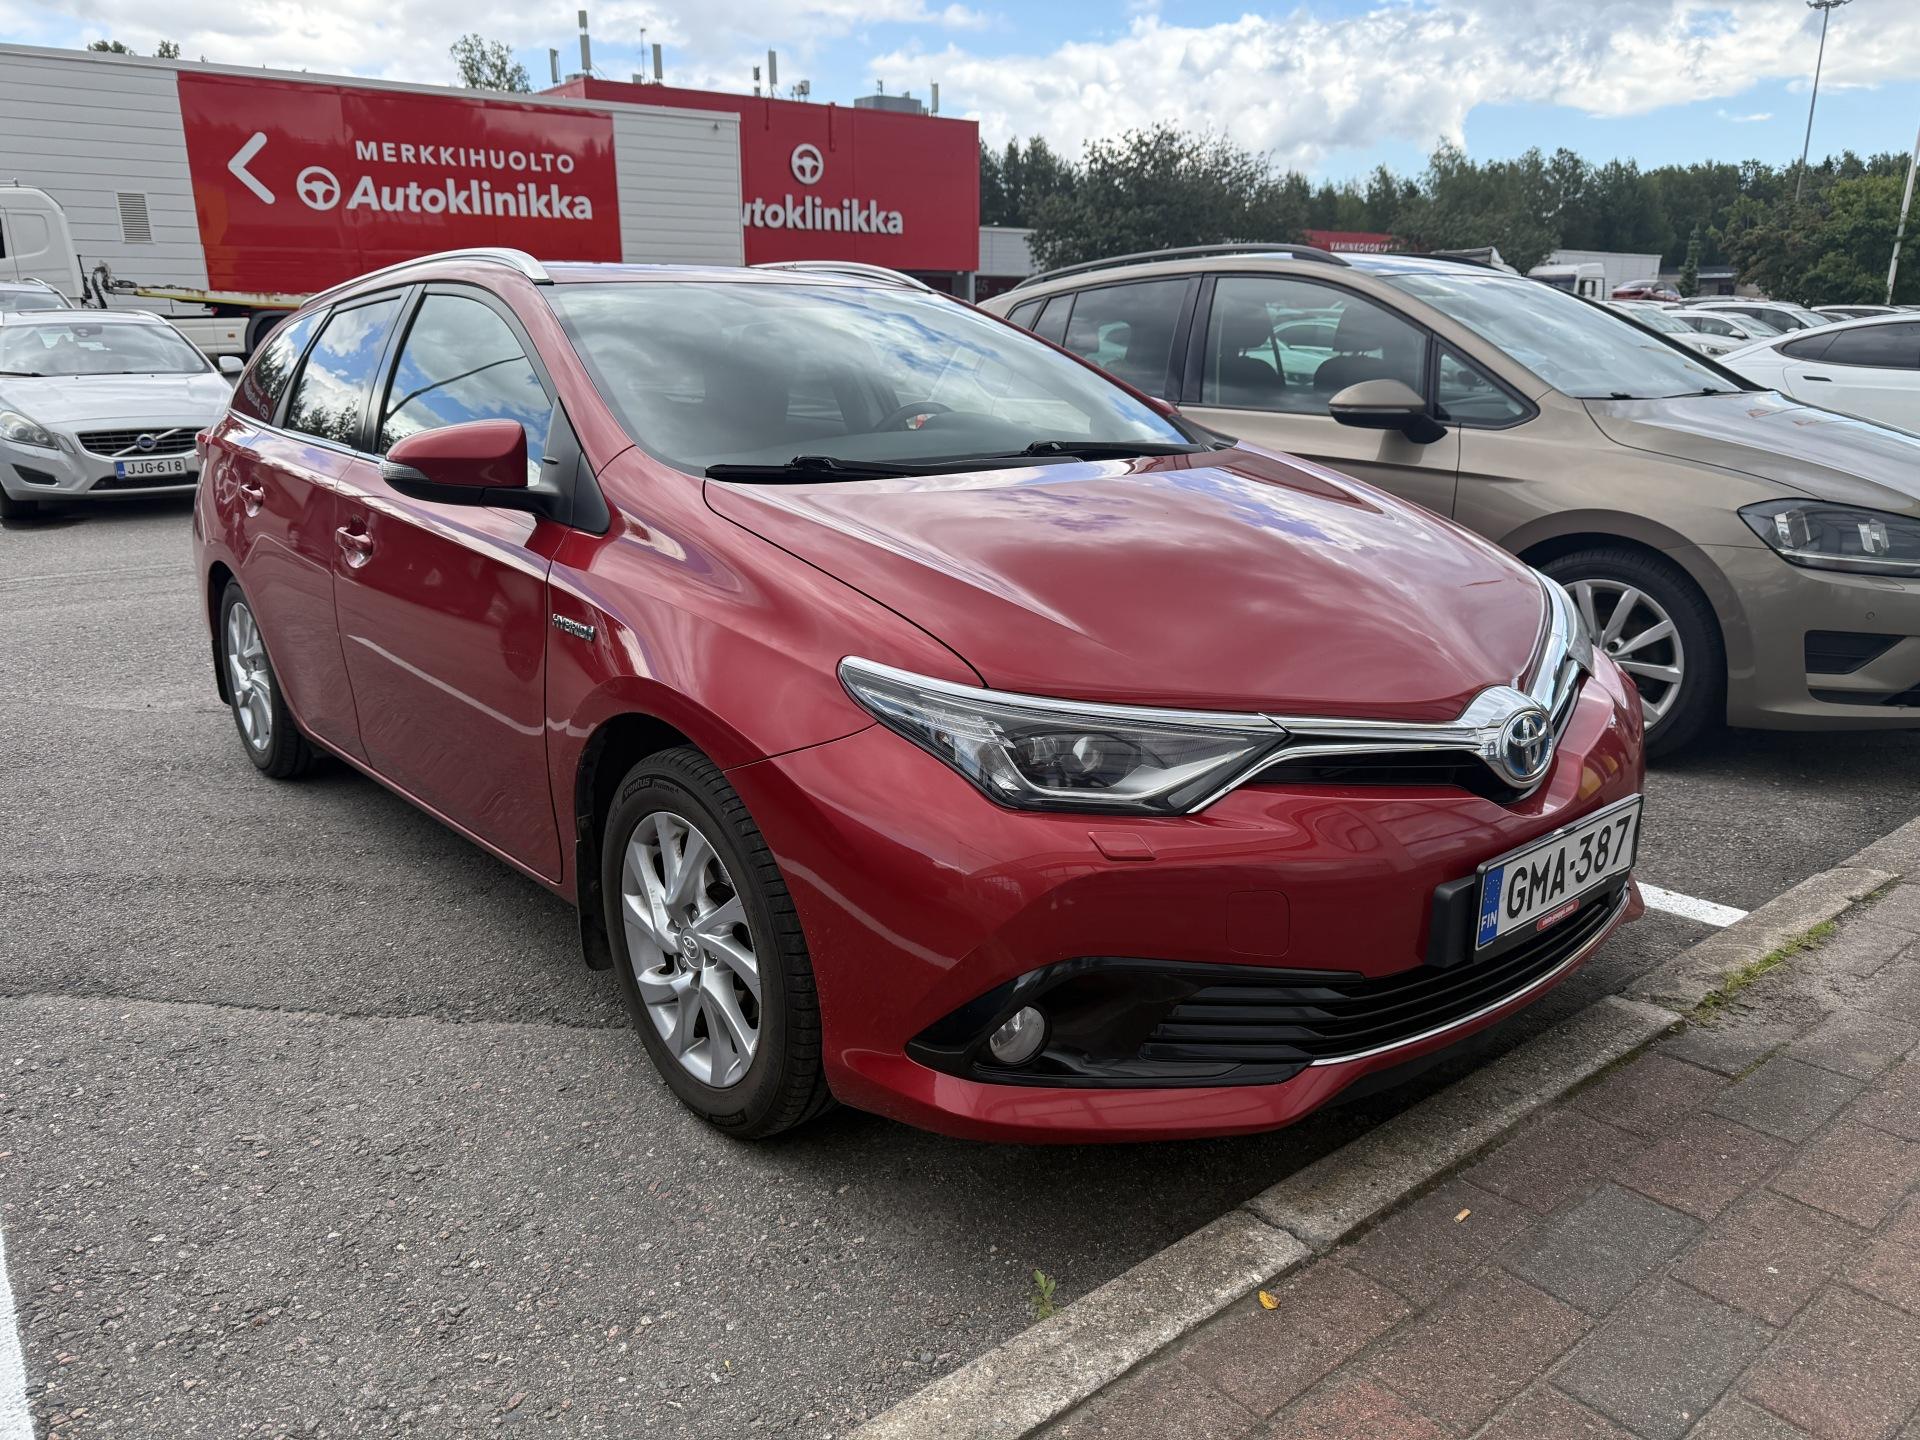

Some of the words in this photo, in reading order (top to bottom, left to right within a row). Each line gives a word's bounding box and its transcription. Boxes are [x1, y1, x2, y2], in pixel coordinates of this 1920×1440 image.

[355, 140, 575, 174] MERKKIHUOLTO
[346, 175, 593, 220] Autoklinikka
[742, 194, 903, 234] utoklinikka
[128, 460, 182, 475] JJG-618
[1506, 814, 1632, 919] GMA-387
[1480, 909, 1498, 931] FIN
